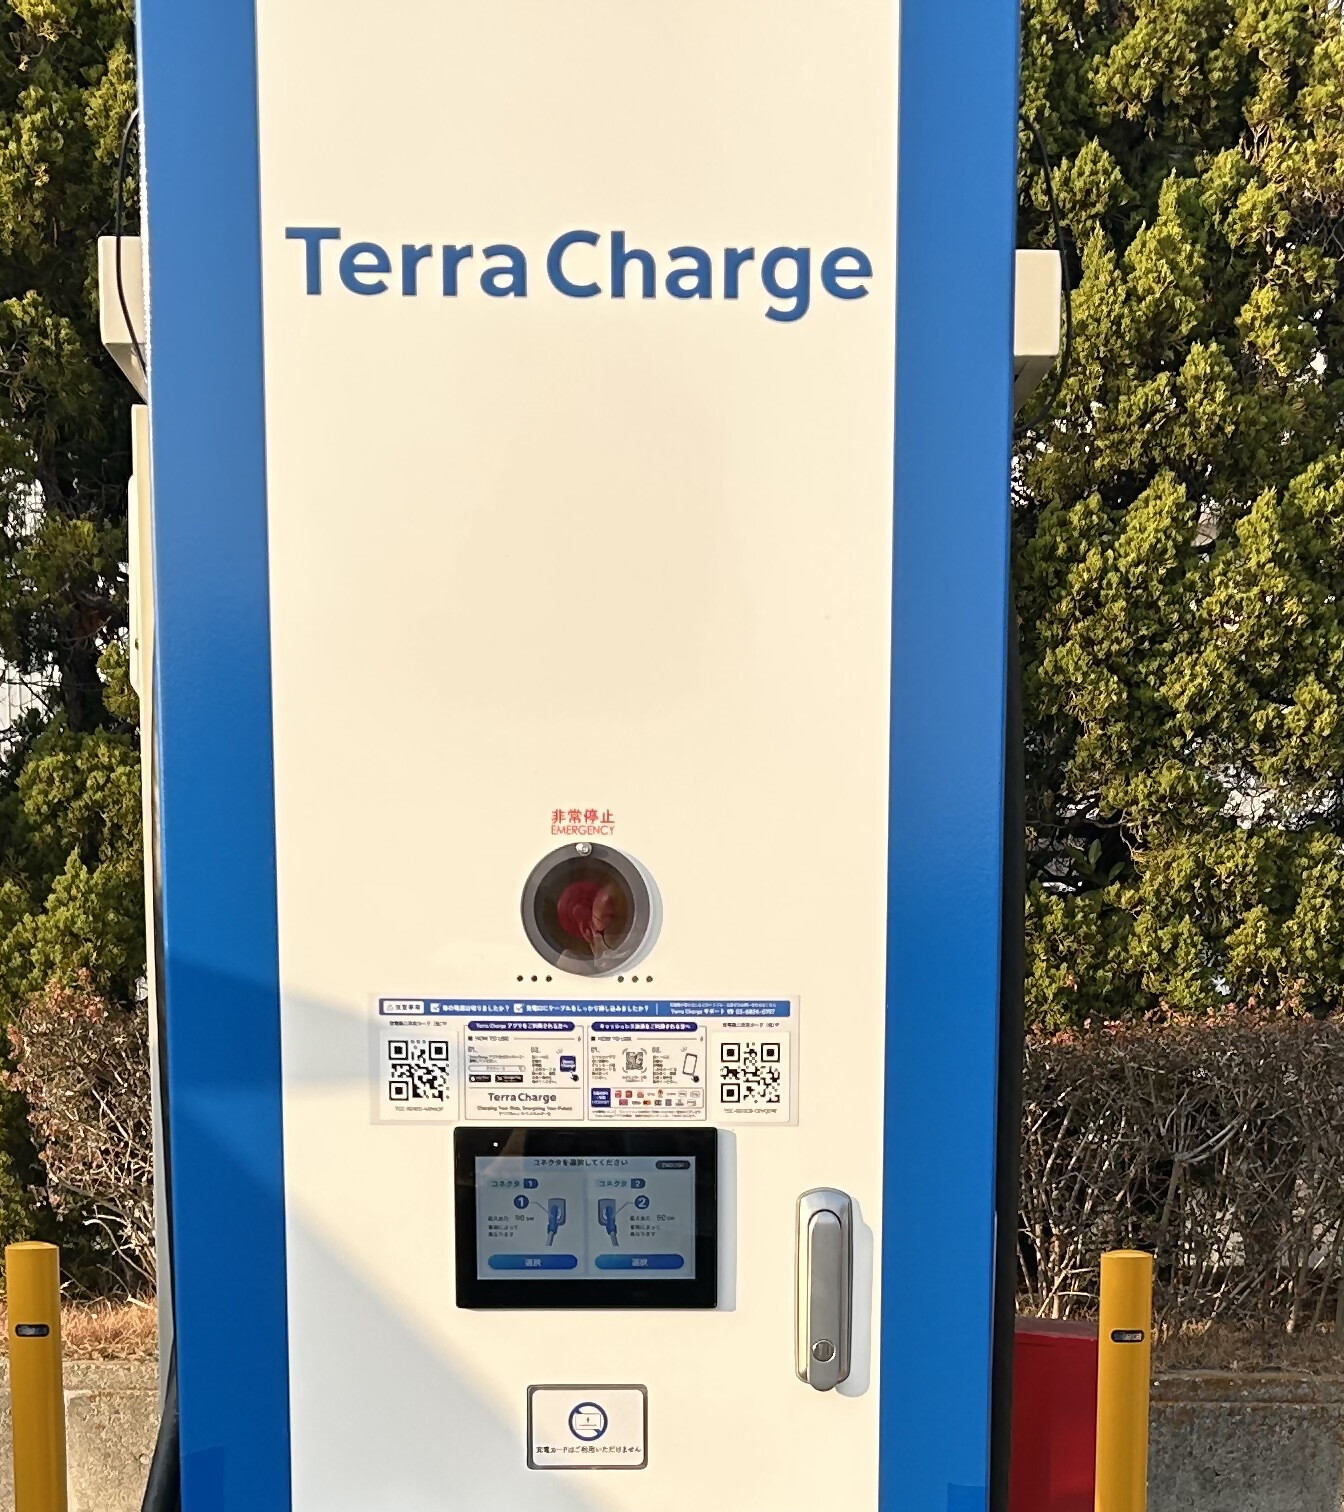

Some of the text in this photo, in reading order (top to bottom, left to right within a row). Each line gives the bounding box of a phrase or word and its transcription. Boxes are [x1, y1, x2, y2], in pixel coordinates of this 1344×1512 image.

[285, 226, 874, 324] Terra Charge
[550, 808, 616, 824] 非常停止
[550, 824, 616, 836] EMERGENCY
[488, 1093, 557, 1104] Terra Charge
[532, 1158, 629, 1167] コネクタを選択してください
[491, 1180, 520, 1188] コネクタ
[517, 1196, 524, 1207] 1
[637, 1197, 646, 1208] 2
[536, 1445, 642, 1454] 充電カードはご利用いただけません
